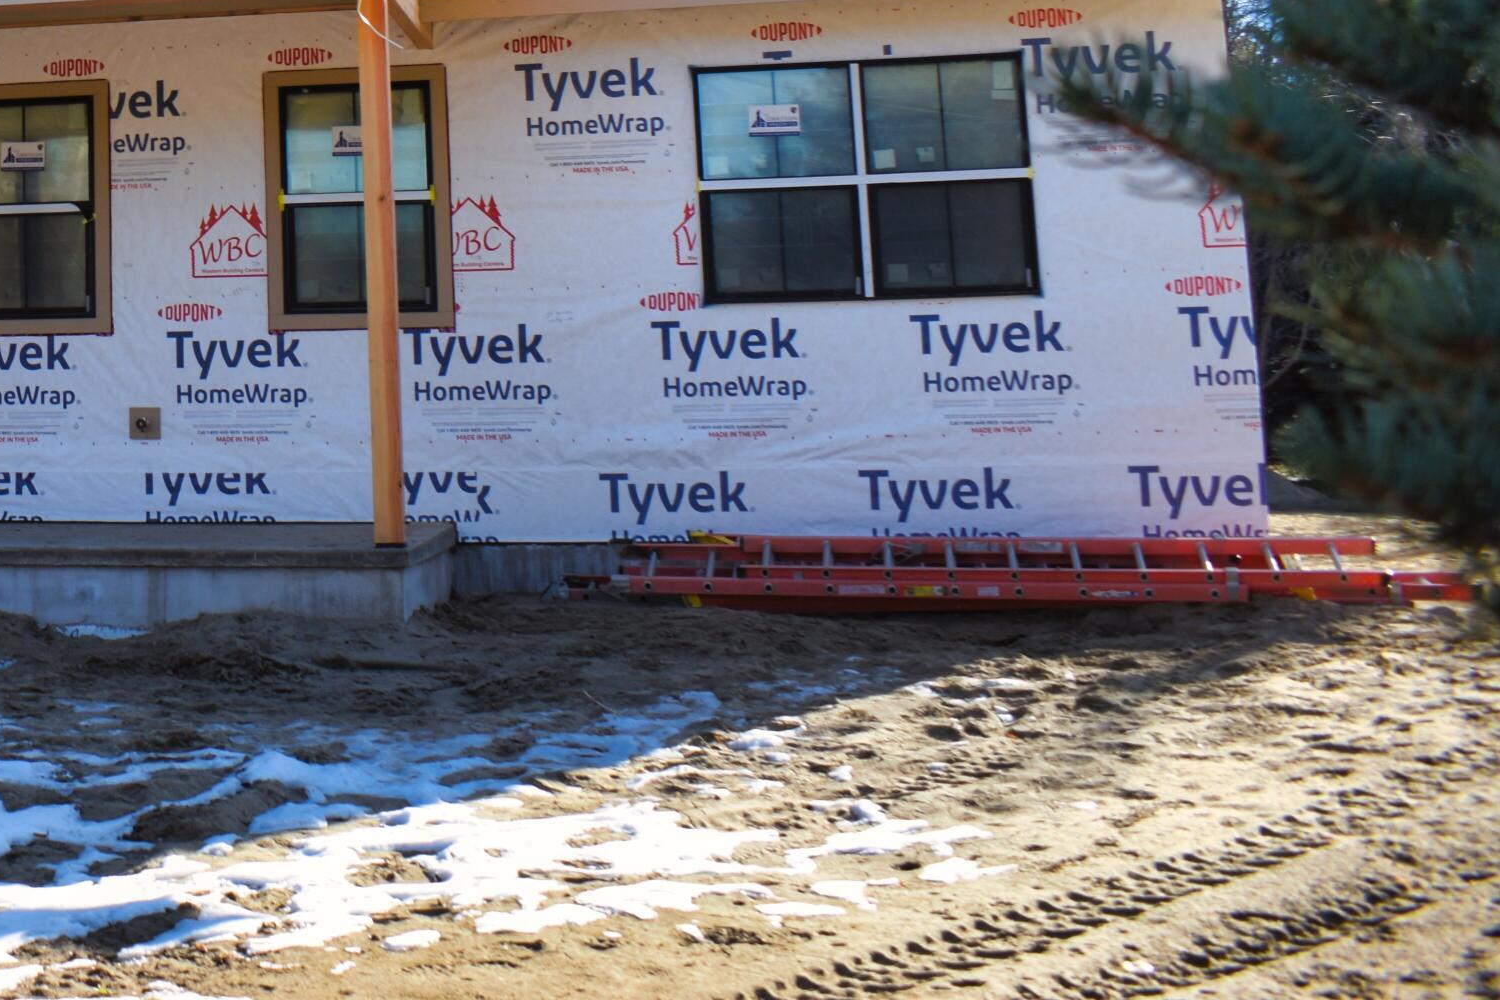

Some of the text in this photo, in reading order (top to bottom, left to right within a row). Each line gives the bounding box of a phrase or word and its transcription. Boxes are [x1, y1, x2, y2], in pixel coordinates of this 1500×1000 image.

[1018, 8, 1073, 28] DUPONT
[512, 35, 565, 54] DUPONT
[760, 22, 814, 42] DUPONT
[50, 59, 98, 77] DUPONT
[275, 47, 326, 67] DUPONT
[514, 57, 658, 112] Tyvek
[526, 113, 665, 137] HomeWrap
[112, 133, 186, 155] eWrap
[198, 233, 262, 265] WBC
[453, 226, 502, 256] BC
[1174, 276, 1234, 296] DUPONT
[165, 303, 216, 322] DUPONT
[403, 324, 544, 377] Tyvek
[651, 317, 800, 372] Tyvek
[909, 310, 1064, 366] Tyvek
[166, 330, 302, 380] Tyvek
[414, 380, 551, 405] HomeWrap
[663, 375, 808, 400] HomeWrap
[924, 370, 1073, 394] HomeWrap
[176, 383, 308, 407] HomeWrap
[599, 471, 748, 525] Tyvek
[859, 467, 1014, 523] Tyvek
[1127, 463, 1267, 519] Tyve
